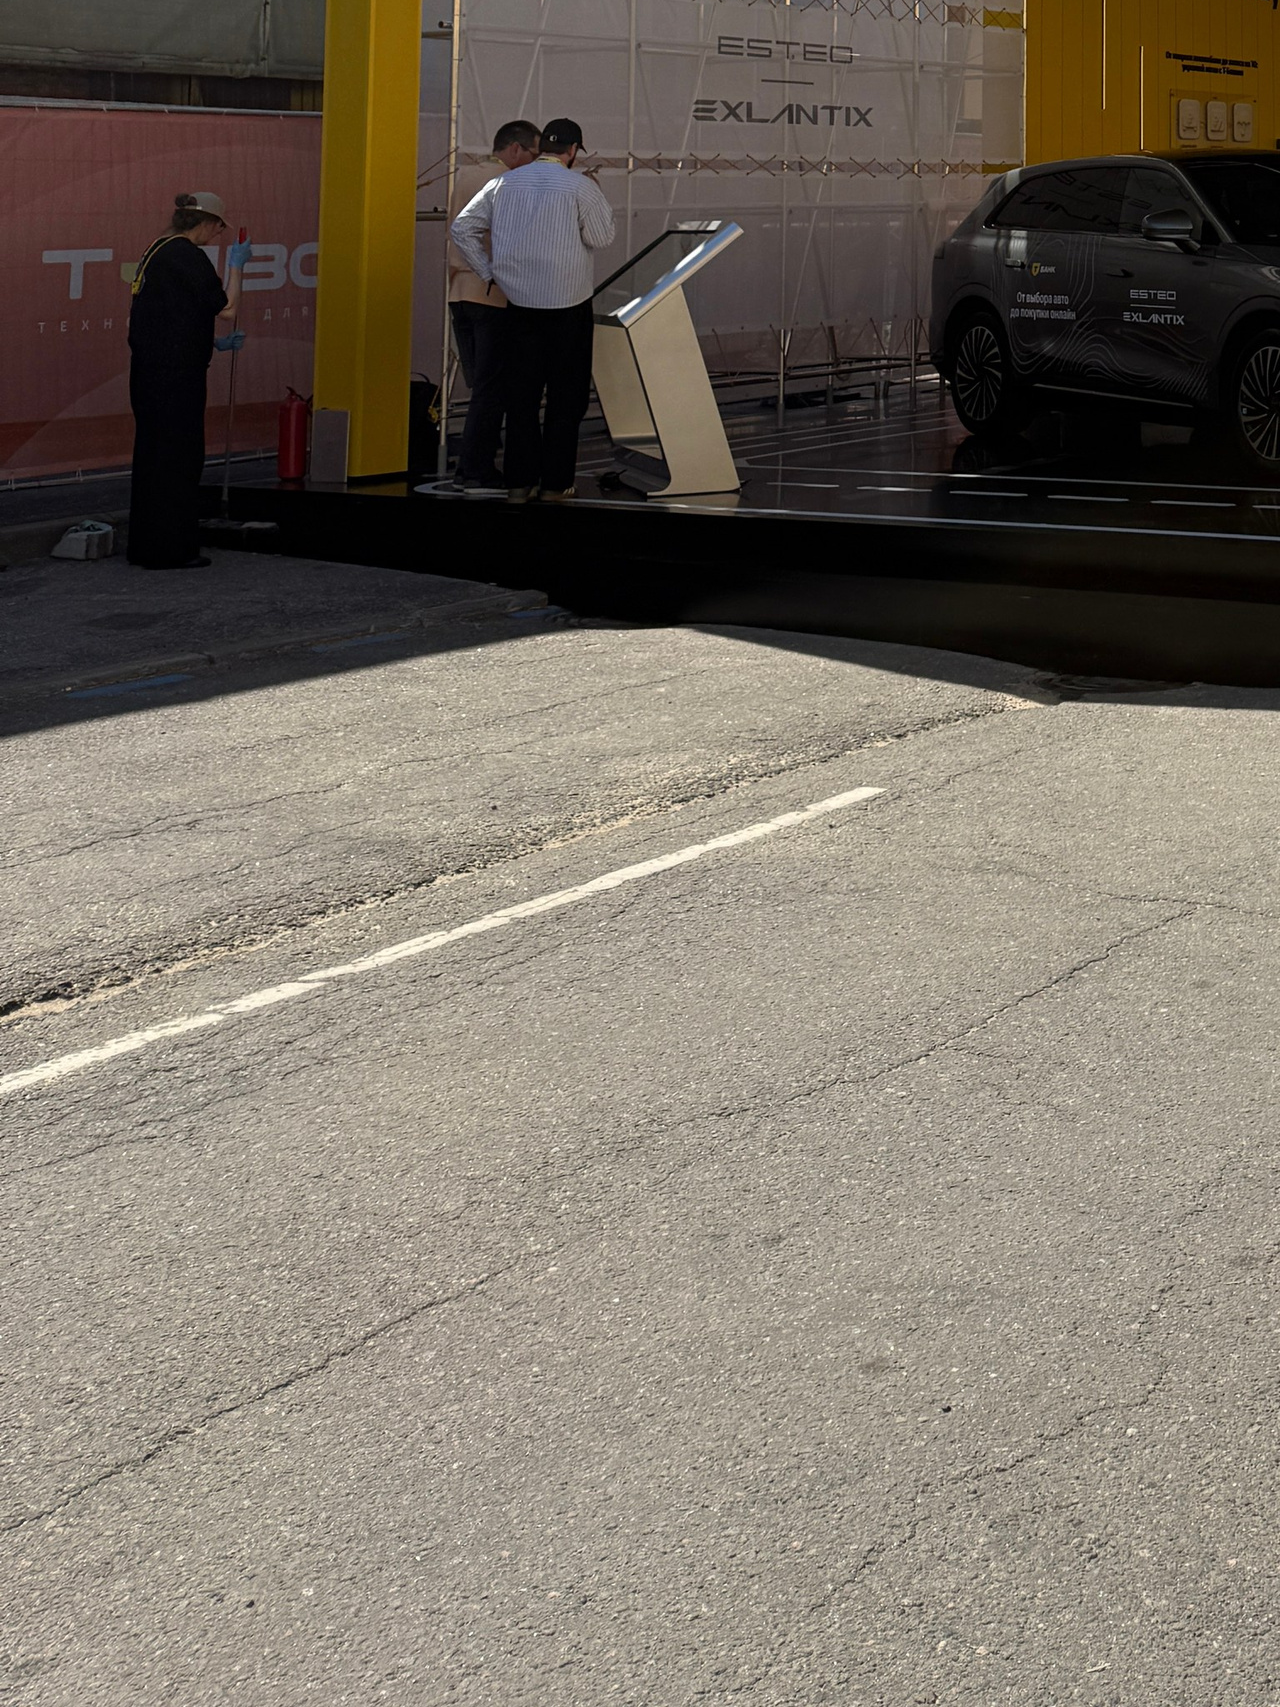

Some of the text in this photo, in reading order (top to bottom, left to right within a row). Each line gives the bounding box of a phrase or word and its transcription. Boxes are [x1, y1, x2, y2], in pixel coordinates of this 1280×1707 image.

[717, 35, 853, 64] ESTEO
[692, 99, 874, 127] EXLANTIX
[1016, 291, 1069, 306] От выбора авто
[1130, 289, 1176, 300] ESTEO
[262, 305, 309, 322] ДЛЯ
[1010, 308, 1076, 320] до покупки онлайн
[1123, 312, 1185, 325] EXLANTIX
